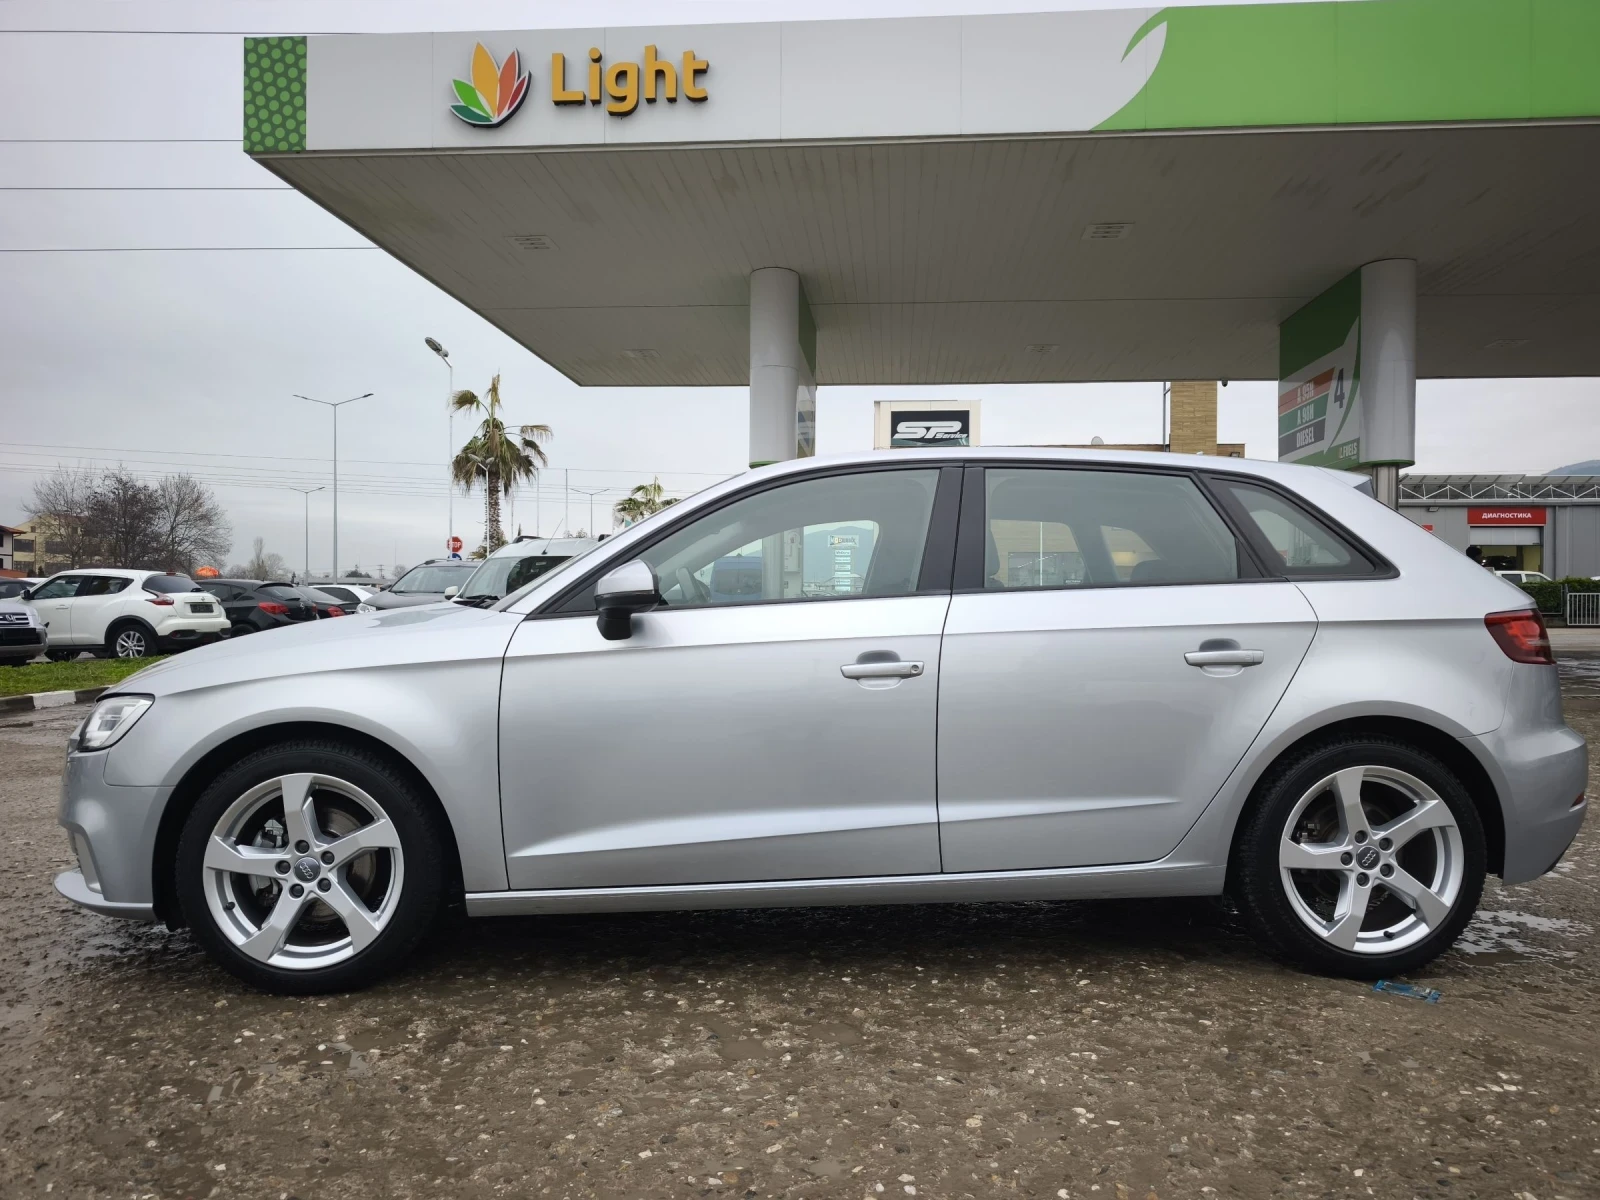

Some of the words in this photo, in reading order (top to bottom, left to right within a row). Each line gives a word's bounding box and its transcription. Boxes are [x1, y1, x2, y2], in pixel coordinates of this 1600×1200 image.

[551, 44, 709, 116] Light
[1333, 368, 1346, 409] 4
[1296, 409, 1302, 426] A
[893, 421, 962, 439] SP
[1296, 427, 1314, 448] DIESEL
